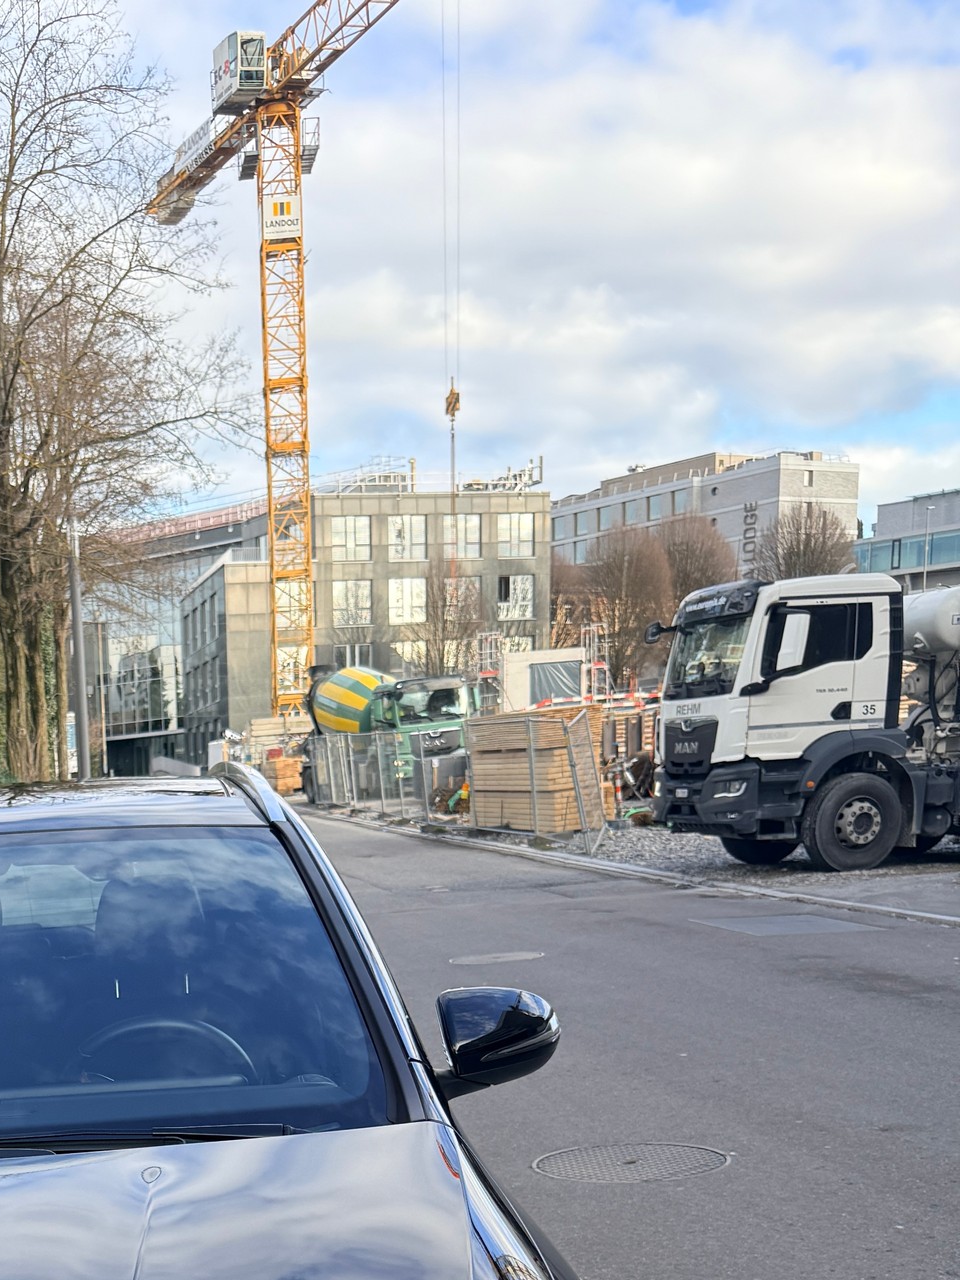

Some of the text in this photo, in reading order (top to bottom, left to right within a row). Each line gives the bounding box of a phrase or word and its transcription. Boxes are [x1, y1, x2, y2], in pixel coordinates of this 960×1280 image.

[265, 218, 300, 228] LANDOLT
[743, 500, 758, 562] LODGE
[676, 703, 701, 717] REHM
[862, 704, 876, 716] 35
[674, 741, 699, 754] MAN
